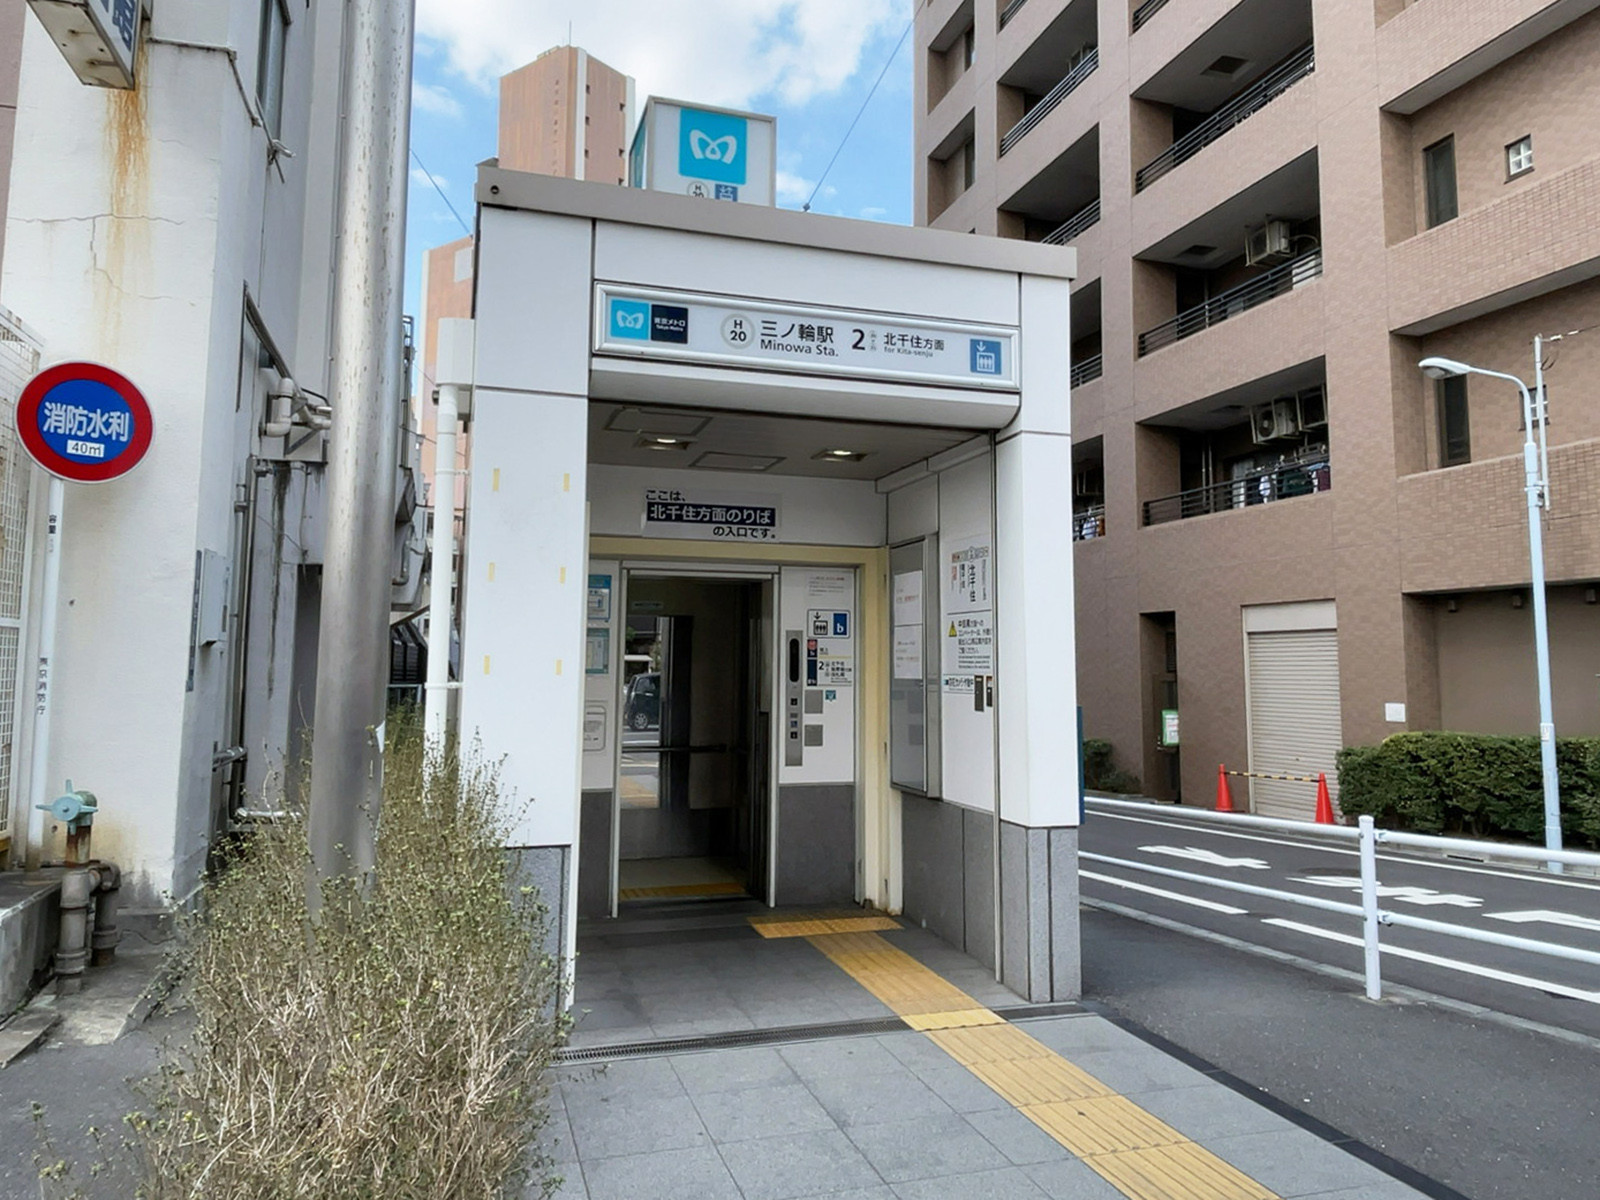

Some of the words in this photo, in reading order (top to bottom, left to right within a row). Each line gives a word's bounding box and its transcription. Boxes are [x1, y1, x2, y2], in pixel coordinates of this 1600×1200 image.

[733, 319, 743, 329] H
[730, 330, 747, 342] 20
[761, 320, 834, 343] 三ノ輪駅
[851, 328, 866, 351] 2
[883, 332, 945, 351] 北千住方面
[760, 339, 812, 354] Minowa
[816, 344, 839, 357] Sta.
[43, 401, 130, 442] 消防水利
[71, 442, 102, 456] 40m
[645, 489, 686, 502] ここは、
[650, 504, 771, 524] 北千住方面のりば
[713, 526, 776, 539] の入口です。
[836, 623, 845, 633] b
[818, 661, 825, 671] 2
